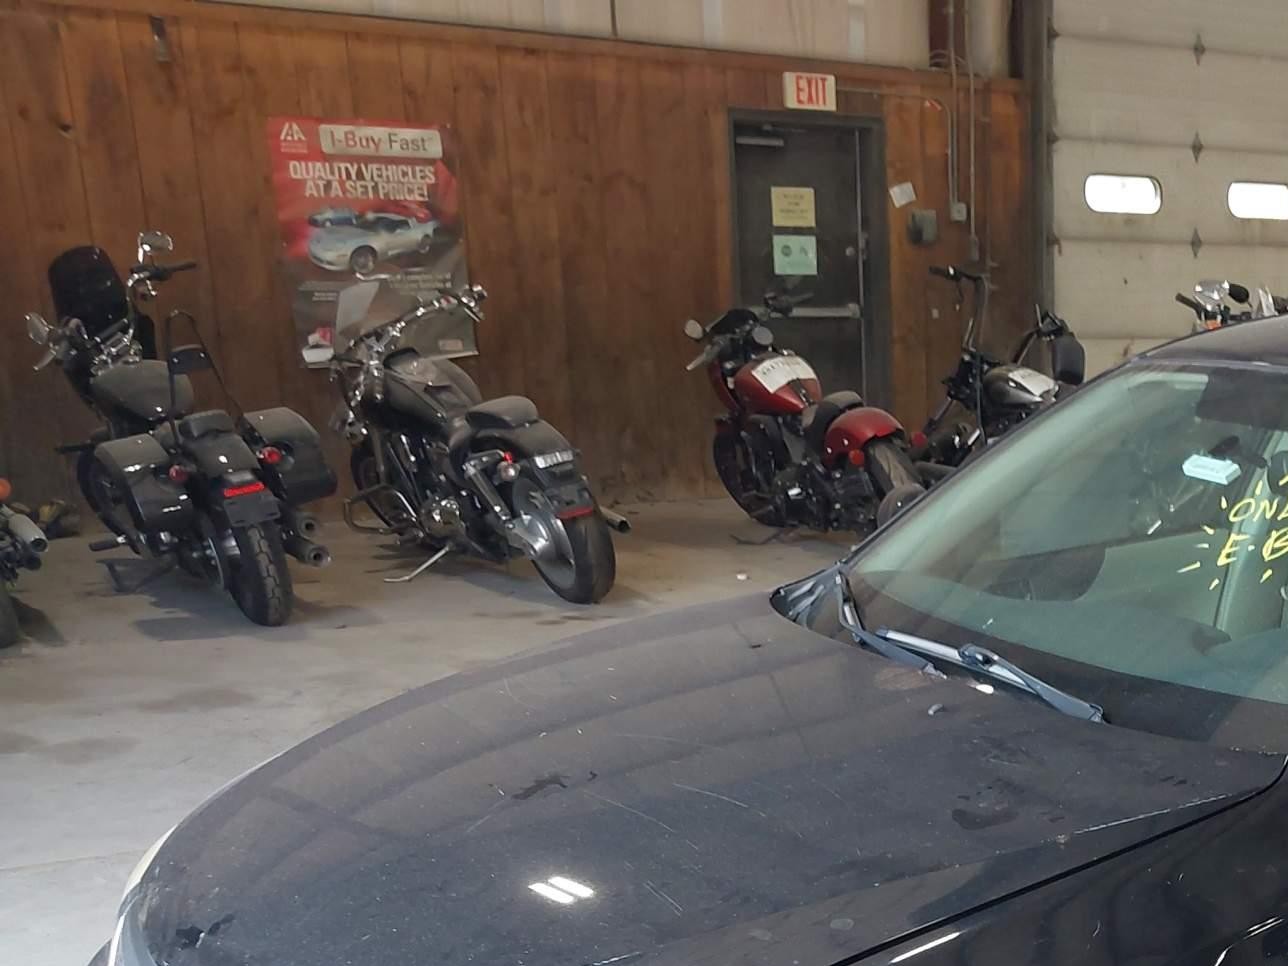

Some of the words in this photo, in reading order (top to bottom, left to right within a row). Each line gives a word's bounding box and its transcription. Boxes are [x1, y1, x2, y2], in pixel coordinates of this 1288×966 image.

[796, 75, 827, 106] EXIT
[331, 129, 381, 152] I-Buy
[289, 160, 358, 181] QUALITY
[360, 163, 435, 184] VEHICLES
[305, 180, 327, 197] AT
[330, 181, 343, 198] A
[346, 181, 375, 200] SET
[378, 182, 429, 201] PRICE!
